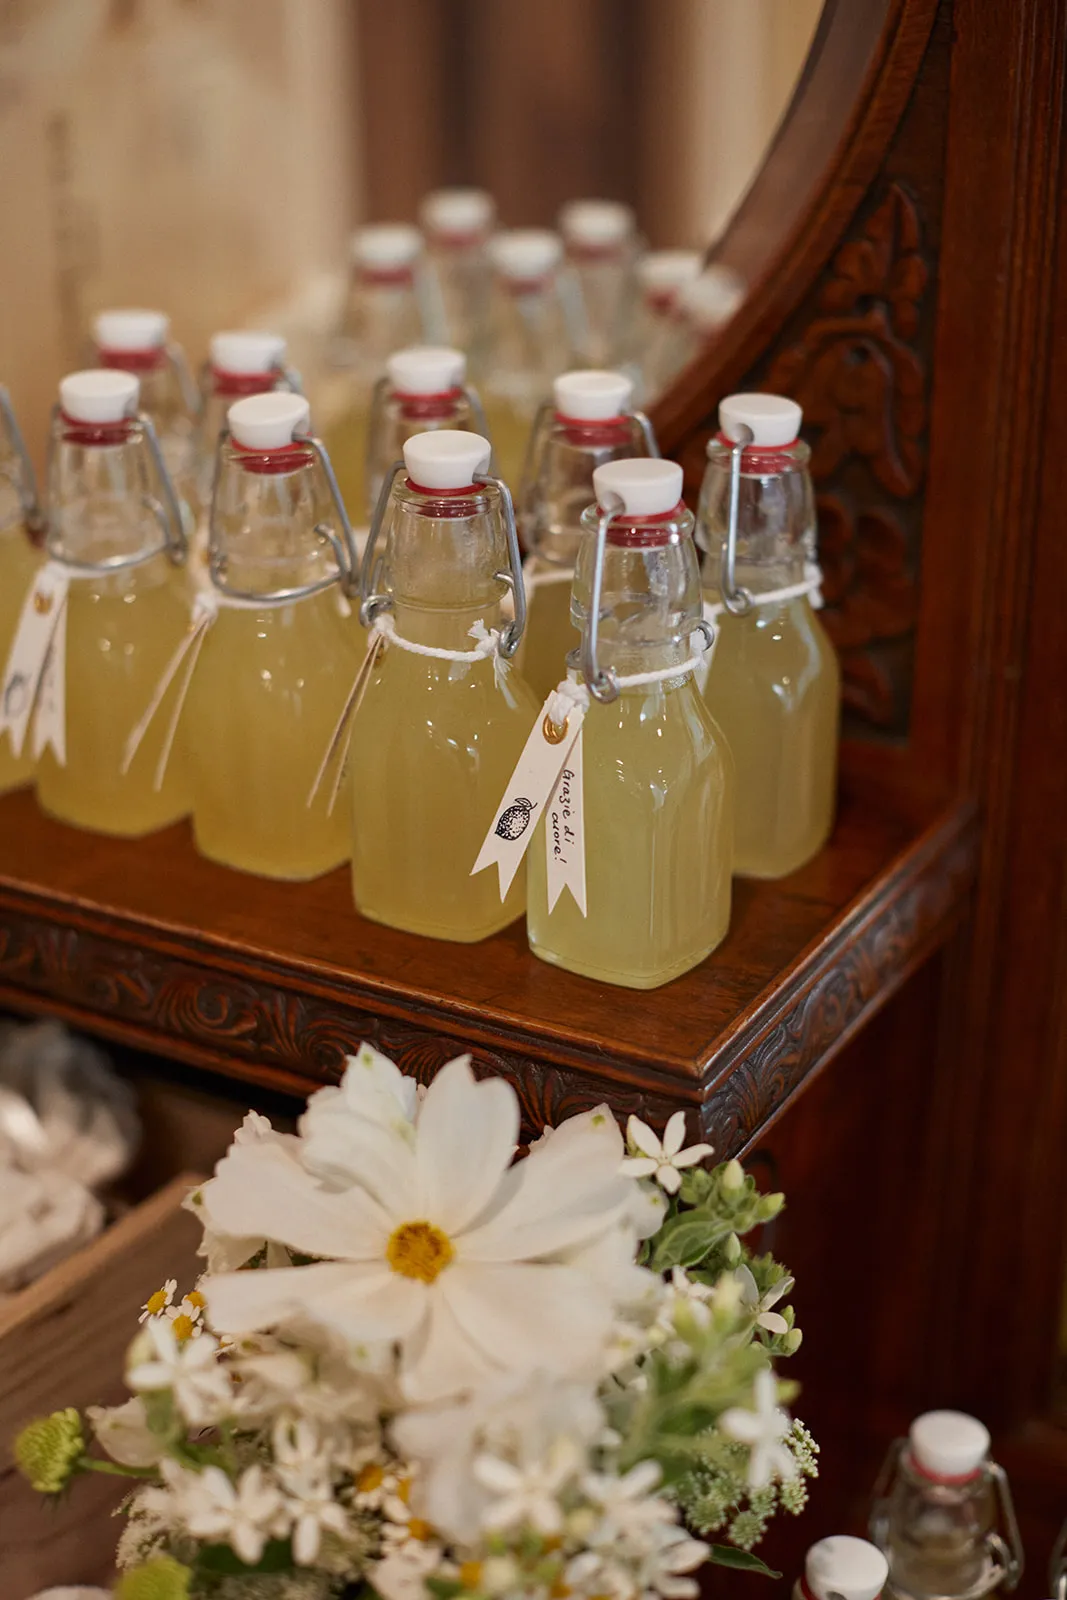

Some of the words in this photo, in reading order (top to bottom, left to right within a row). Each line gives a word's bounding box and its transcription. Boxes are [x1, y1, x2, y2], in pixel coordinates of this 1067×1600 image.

[559, 769, 575, 819] Grazie
[551, 812, 568, 864] cuore!
[563, 825, 575, 845] di
